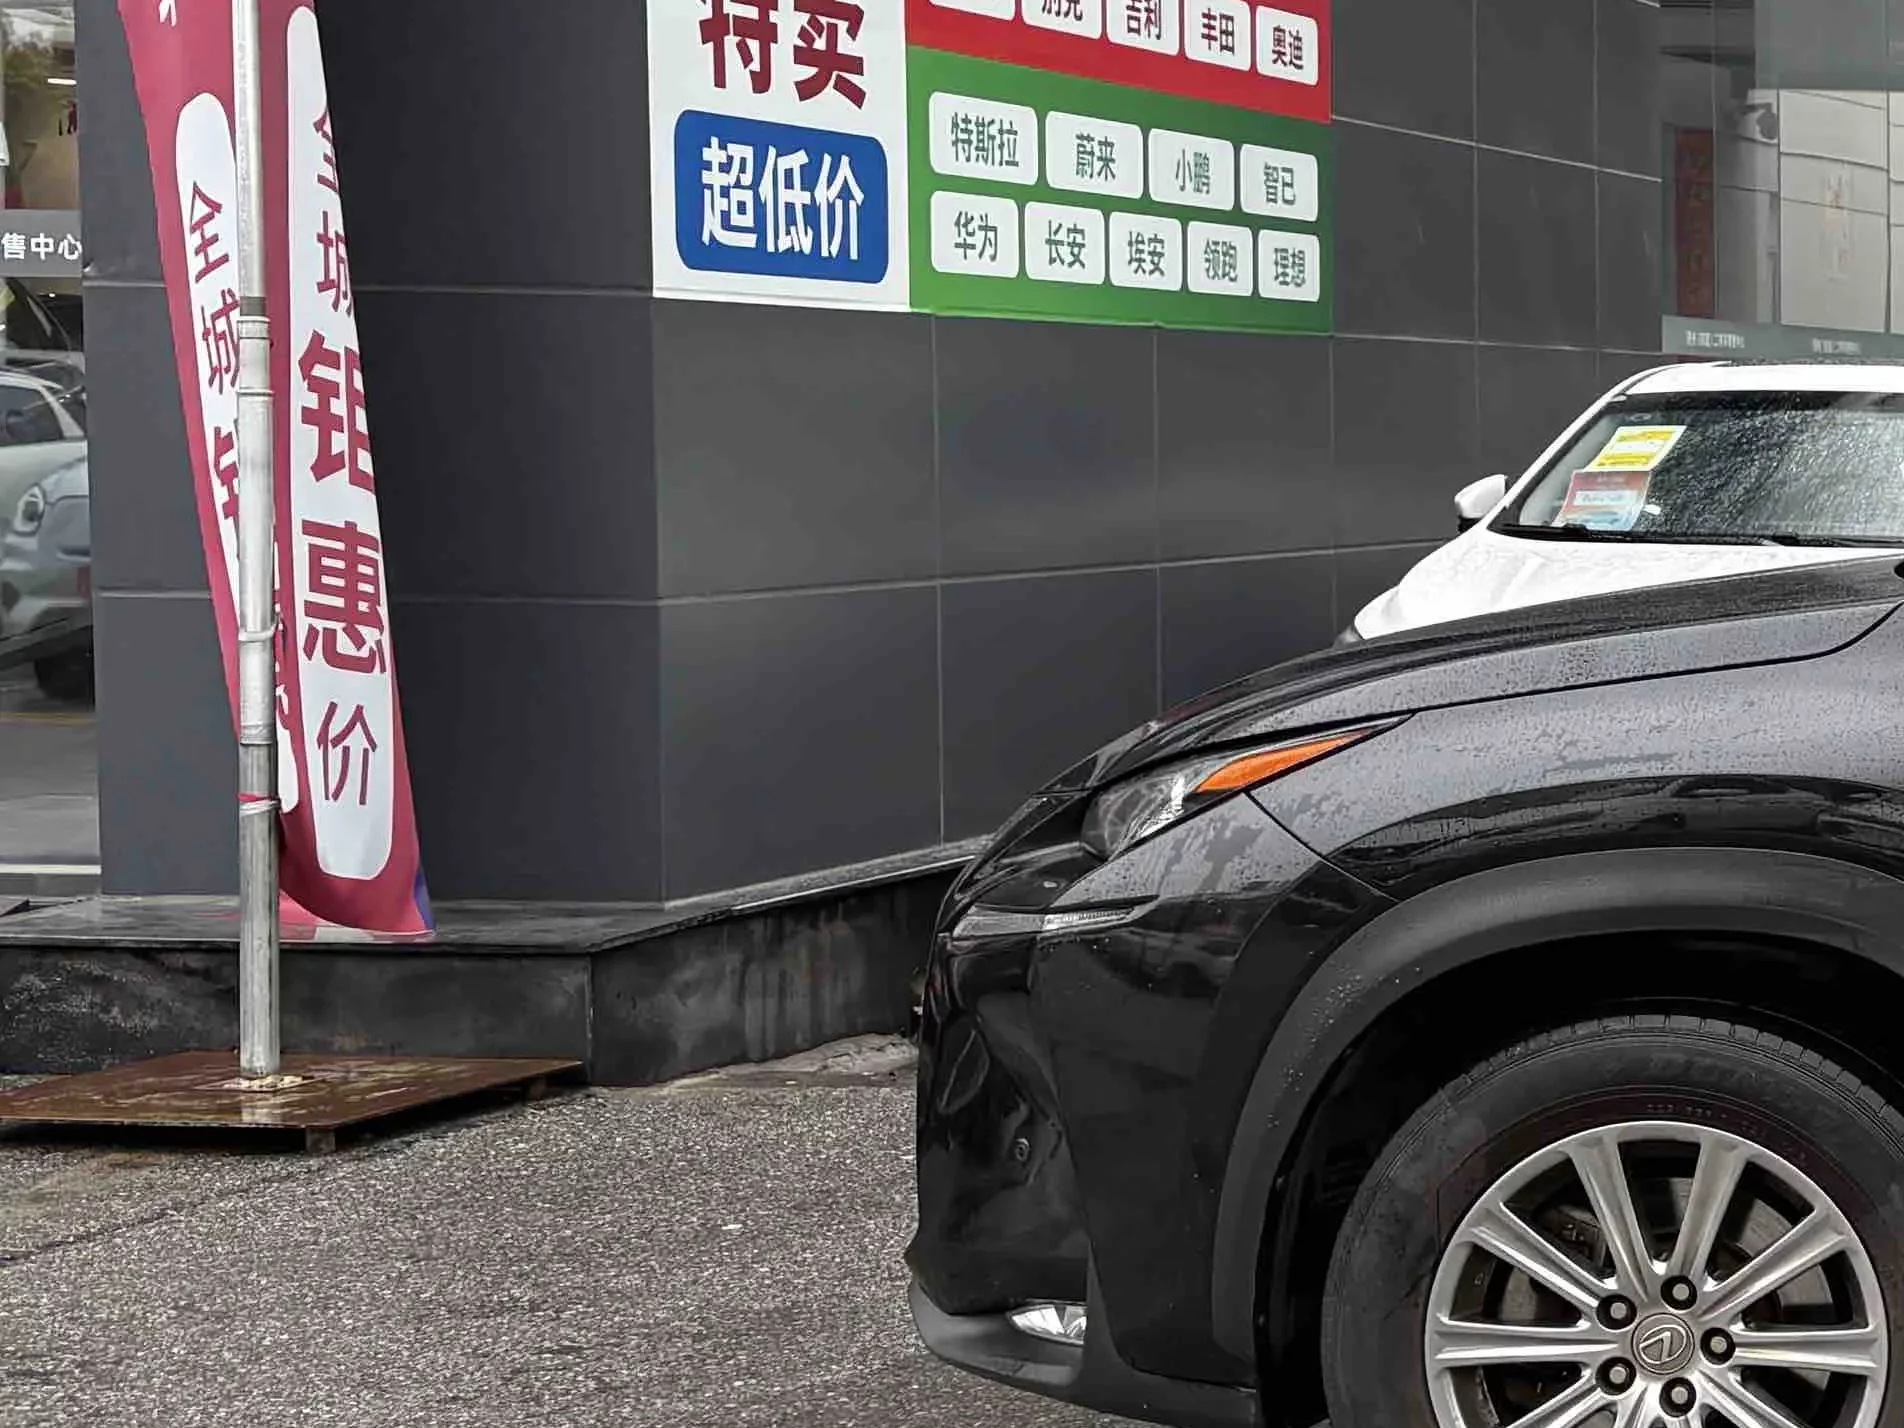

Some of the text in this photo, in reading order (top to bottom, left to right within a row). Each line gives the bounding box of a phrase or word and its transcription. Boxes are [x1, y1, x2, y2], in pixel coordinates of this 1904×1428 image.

[1201, 8, 1235, 55] 丰田
[1272, 25, 1304, 70] 奥迪
[951, 112, 1296, 206] 特斯拉 蔚来 小鹏 智己
[701, 136, 864, 261] 超低价
[1, 232, 82, 261] 售中心
[954, 211, 1306, 288] 华为 长安 埃安 领跑 理想
